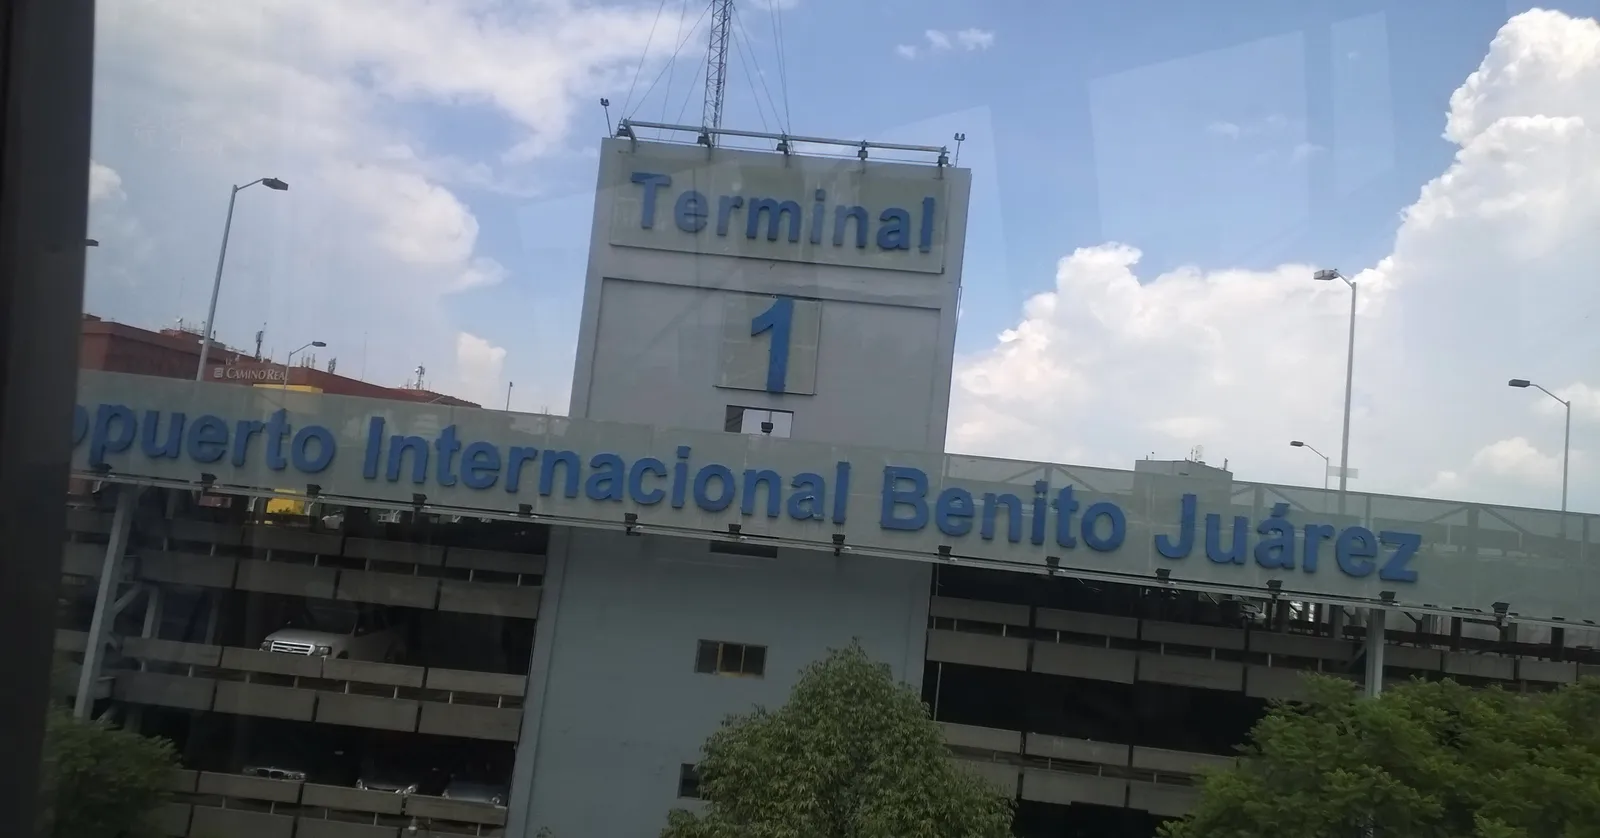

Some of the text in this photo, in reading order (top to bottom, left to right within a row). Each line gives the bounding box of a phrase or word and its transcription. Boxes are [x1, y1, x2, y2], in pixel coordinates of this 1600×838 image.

[631, 171, 936, 253] Terminal
[226, 367, 266, 380] CAMINO
[751, 296, 794, 393] 1
[362, 415, 851, 525] Internacional
[880, 465, 1126, 552] Benito
[1154, 493, 1421, 583] Juárez
